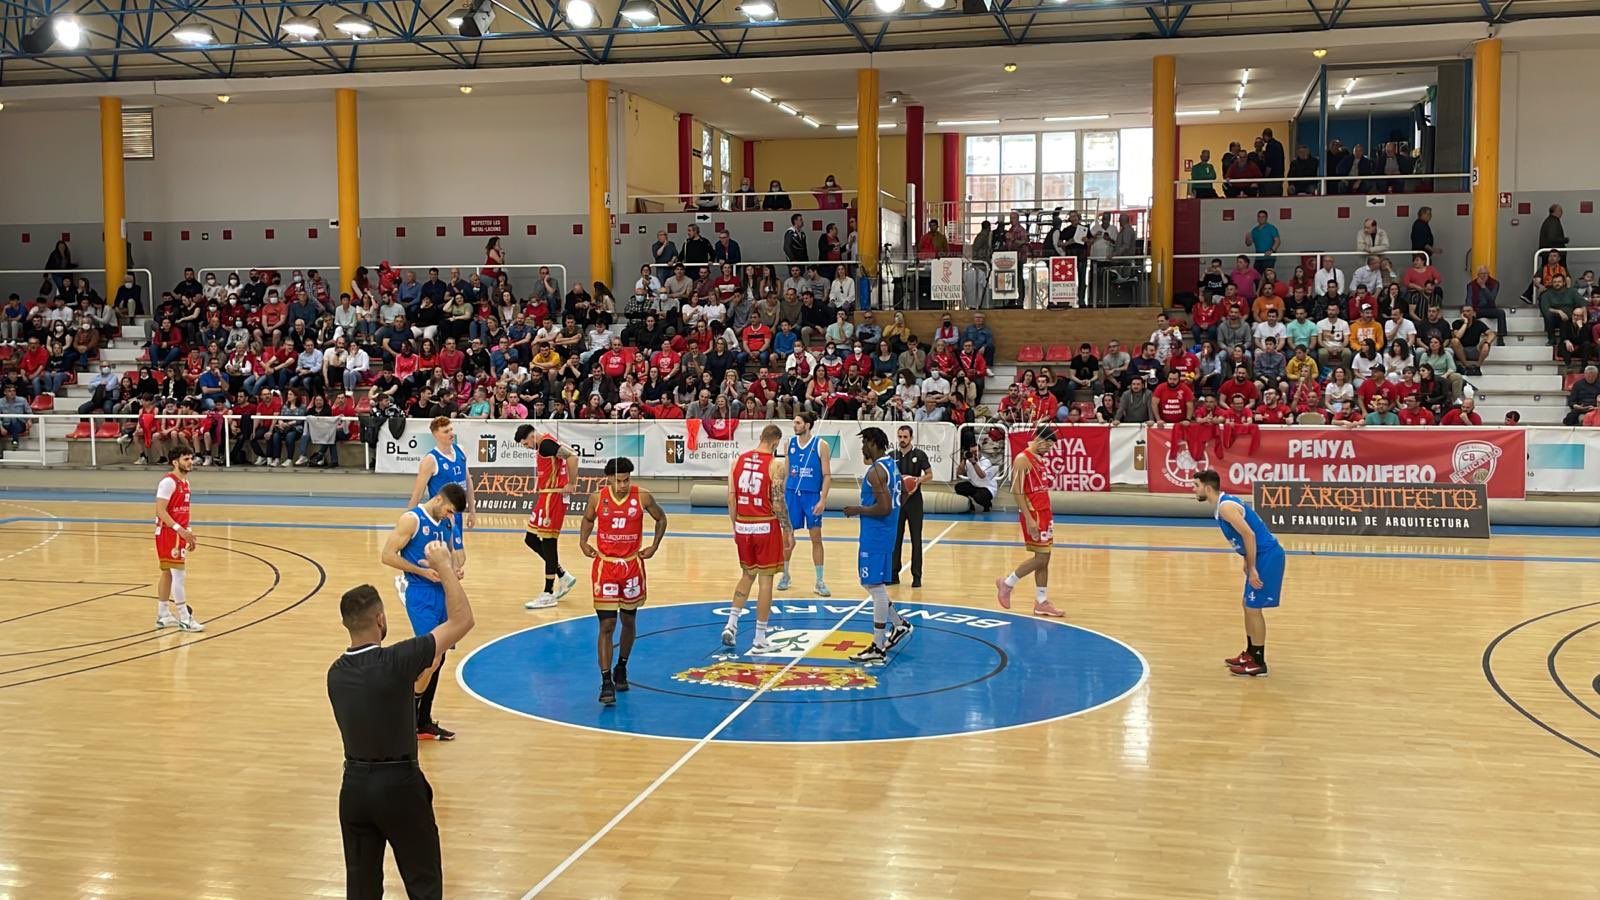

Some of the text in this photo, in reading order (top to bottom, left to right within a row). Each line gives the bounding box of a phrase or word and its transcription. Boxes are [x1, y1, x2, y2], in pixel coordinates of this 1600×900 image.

[689, 451, 699, 459] de
[1288, 440, 1356, 459] PENYA
[799, 454, 805, 462] 7
[452, 466, 462, 475] 12
[1042, 456, 1096, 474] RGULL
[1229, 463, 1436, 484] ORGULL KADUFERO
[738, 470, 764, 495] 45
[1260, 484, 1479, 512] MI ARQUITECTO
[522, 500, 533, 509] DE
[611, 518, 627, 529] 30
[1271, 515, 1470, 528] LA FRANQUICIA DE ARQUITECTURA
[625, 576, 639, 588] 30
